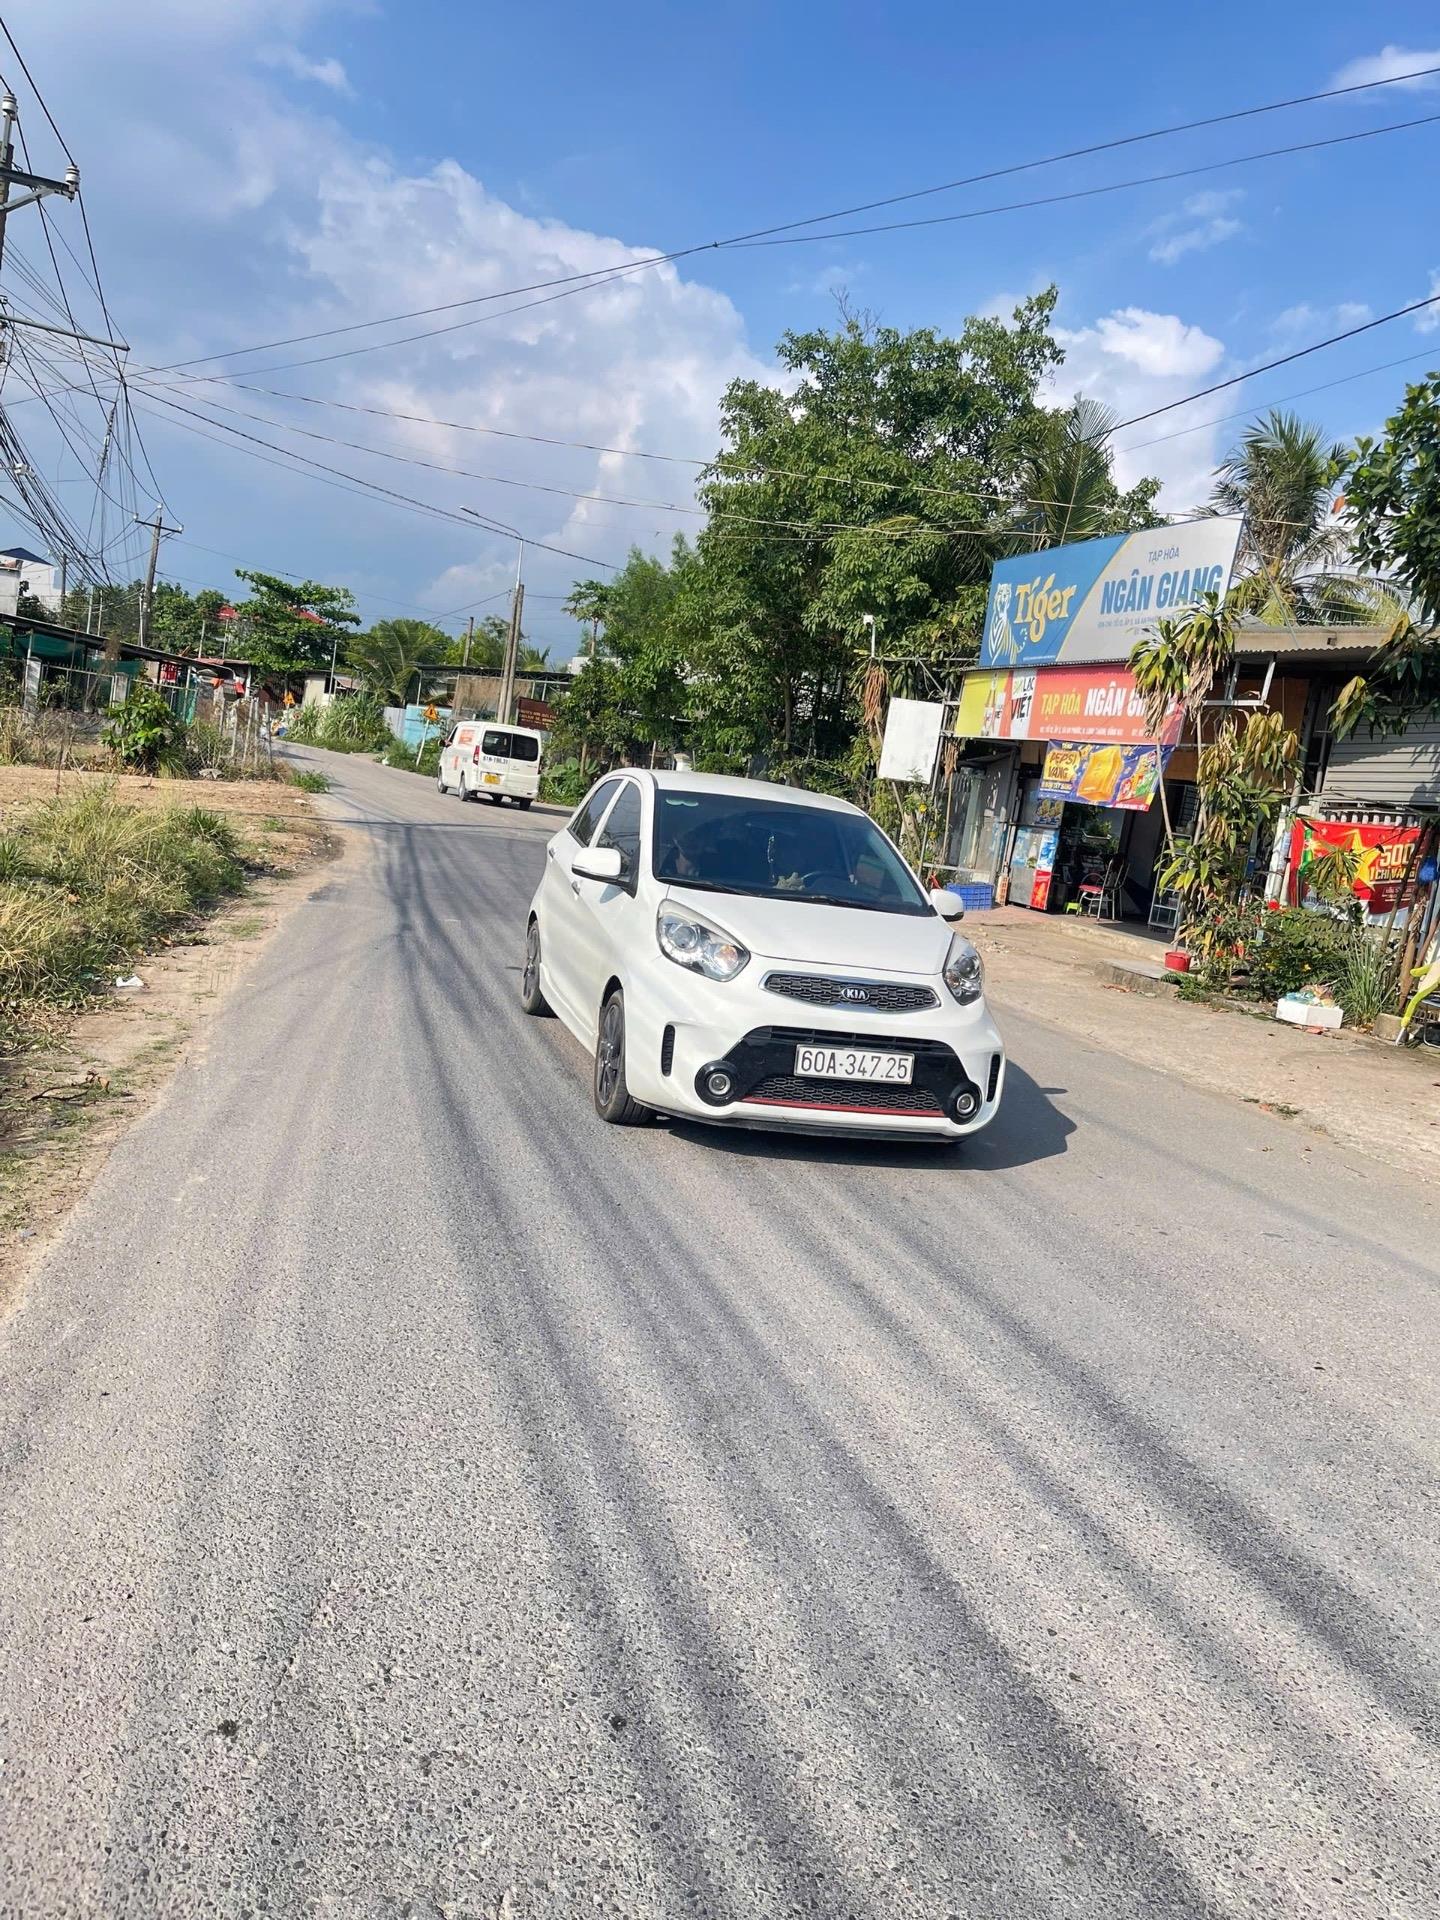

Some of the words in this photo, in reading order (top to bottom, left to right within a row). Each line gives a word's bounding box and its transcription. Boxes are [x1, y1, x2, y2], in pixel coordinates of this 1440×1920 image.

[1100, 568, 1154, 615] NGÂN
[1156, 564, 1223, 609] GIANG
[1013, 572, 1077, 643] Tiger
[1040, 694, 1060, 721] TẠP
[1084, 680, 1128, 717] NGÂN
[846, 989, 866, 999] KIA
[801, 1050, 908, 1079] 60A-347.25
